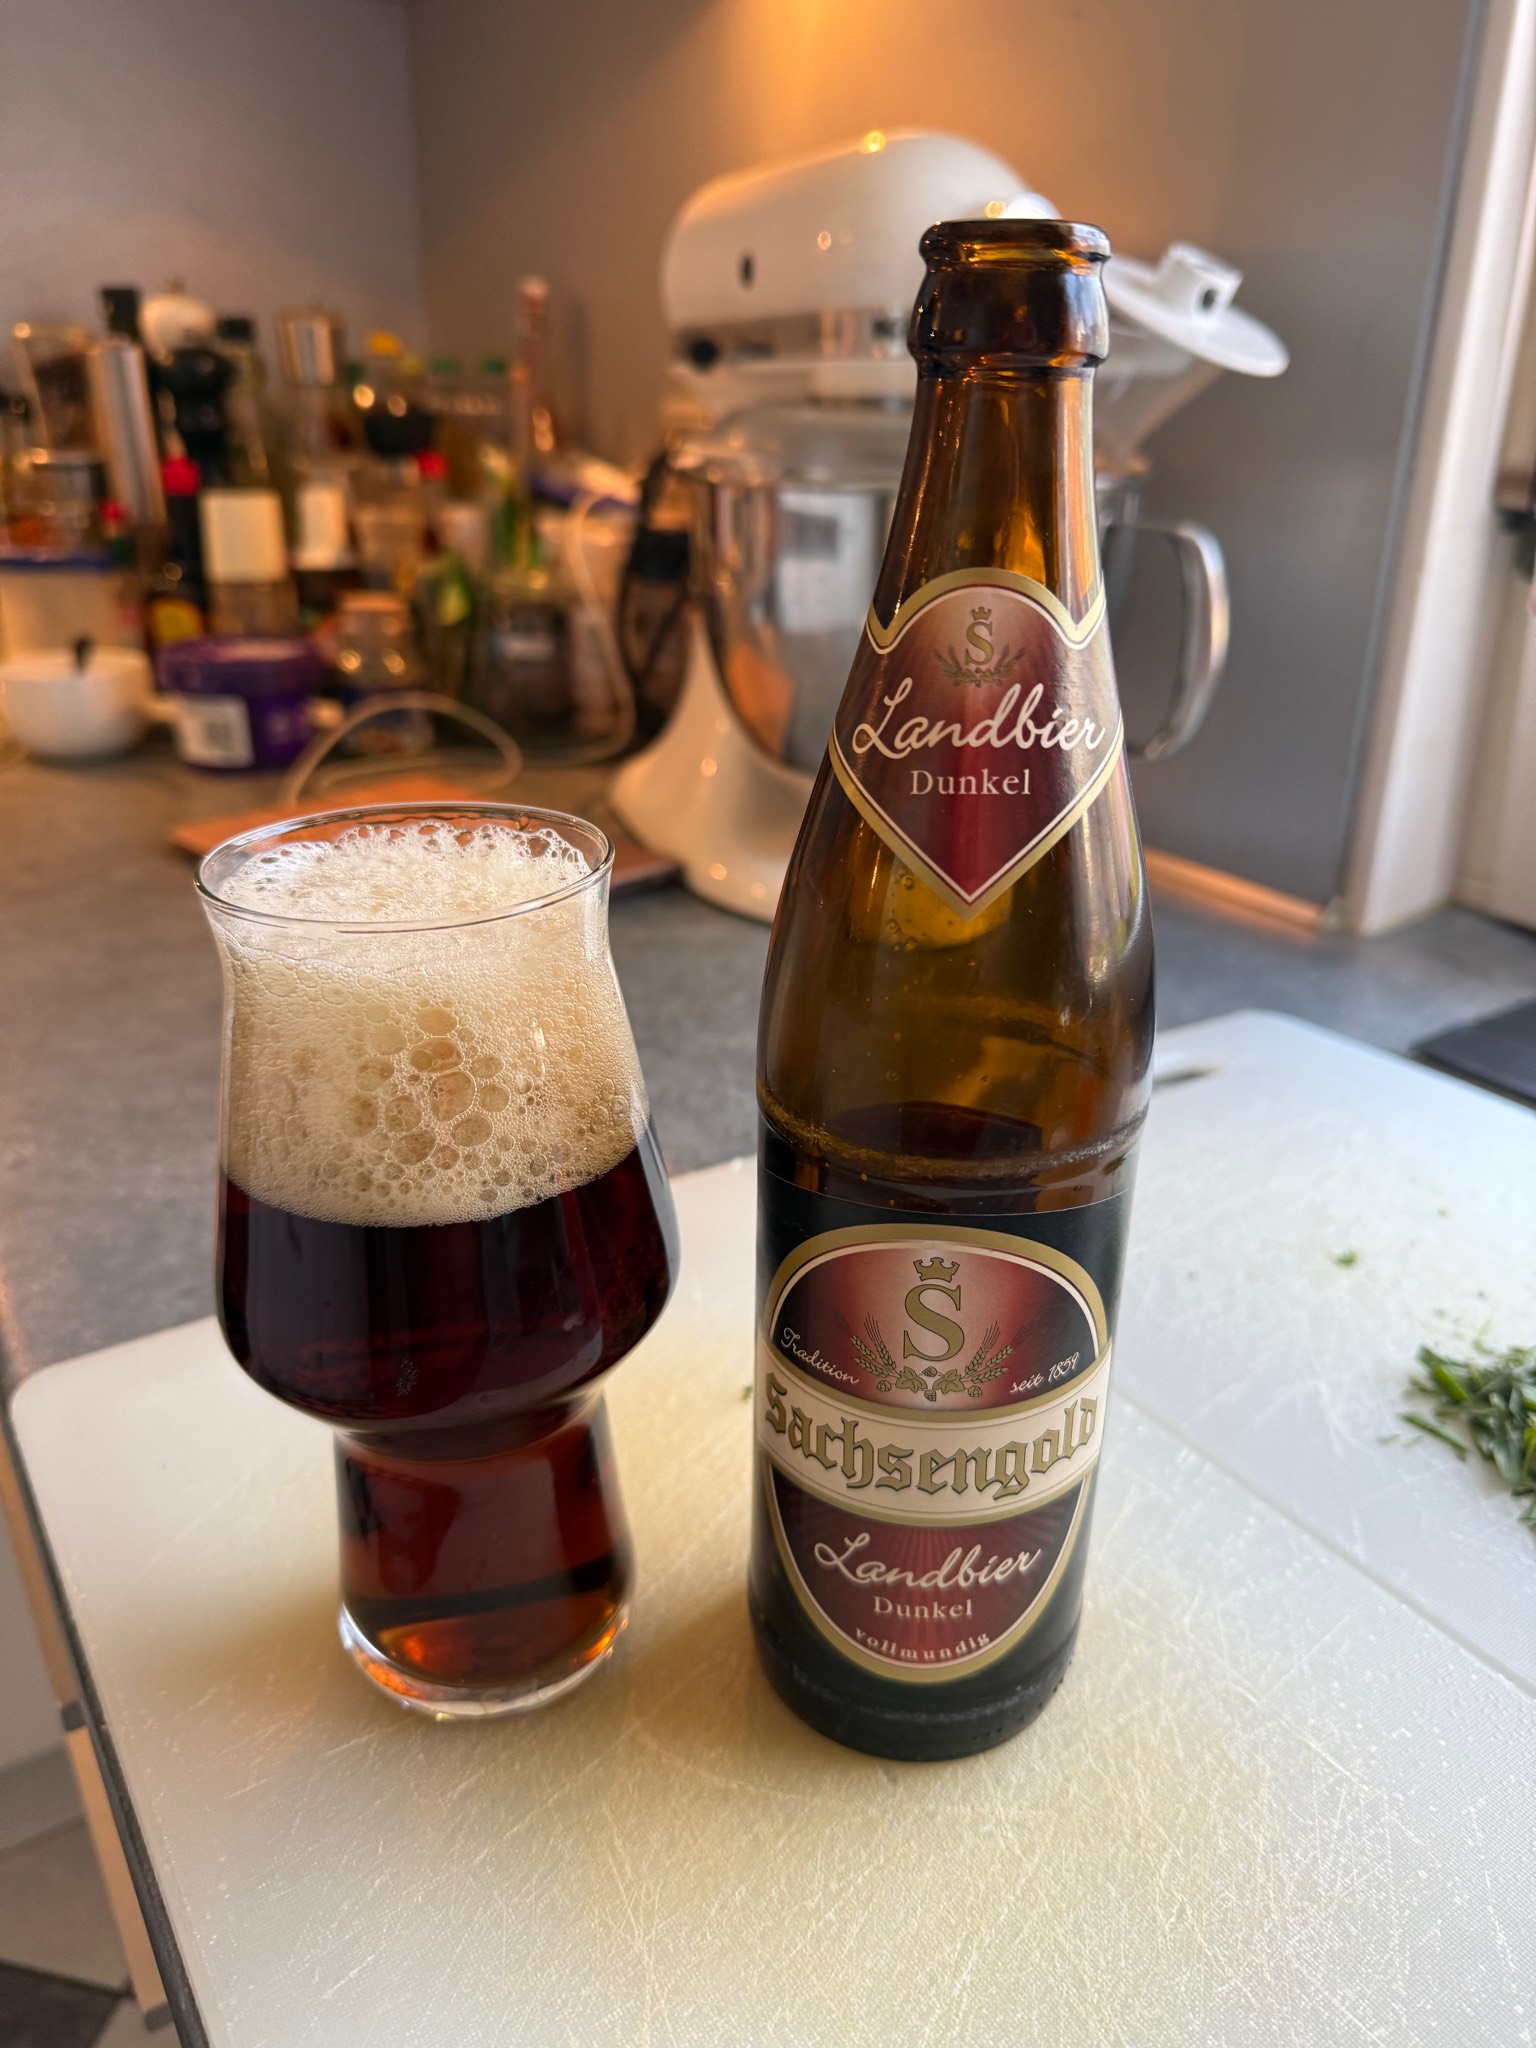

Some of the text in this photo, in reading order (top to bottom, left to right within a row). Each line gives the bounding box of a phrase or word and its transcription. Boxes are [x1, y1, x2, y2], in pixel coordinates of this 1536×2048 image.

[965, 621, 994, 665] S
[852, 677, 1105, 759] Landbier
[910, 769, 1031, 795] Dunkel
[903, 1284, 965, 1361] S
[781, 1327, 1079, 1393] Tradition seit 1859
[765, 1372, 1098, 1500] Sachsengold
[814, 1532, 1041, 1588] Landbier
[873, 1596, 972, 1618] Dunkel
[856, 1628, 990, 1660] vollmundig
